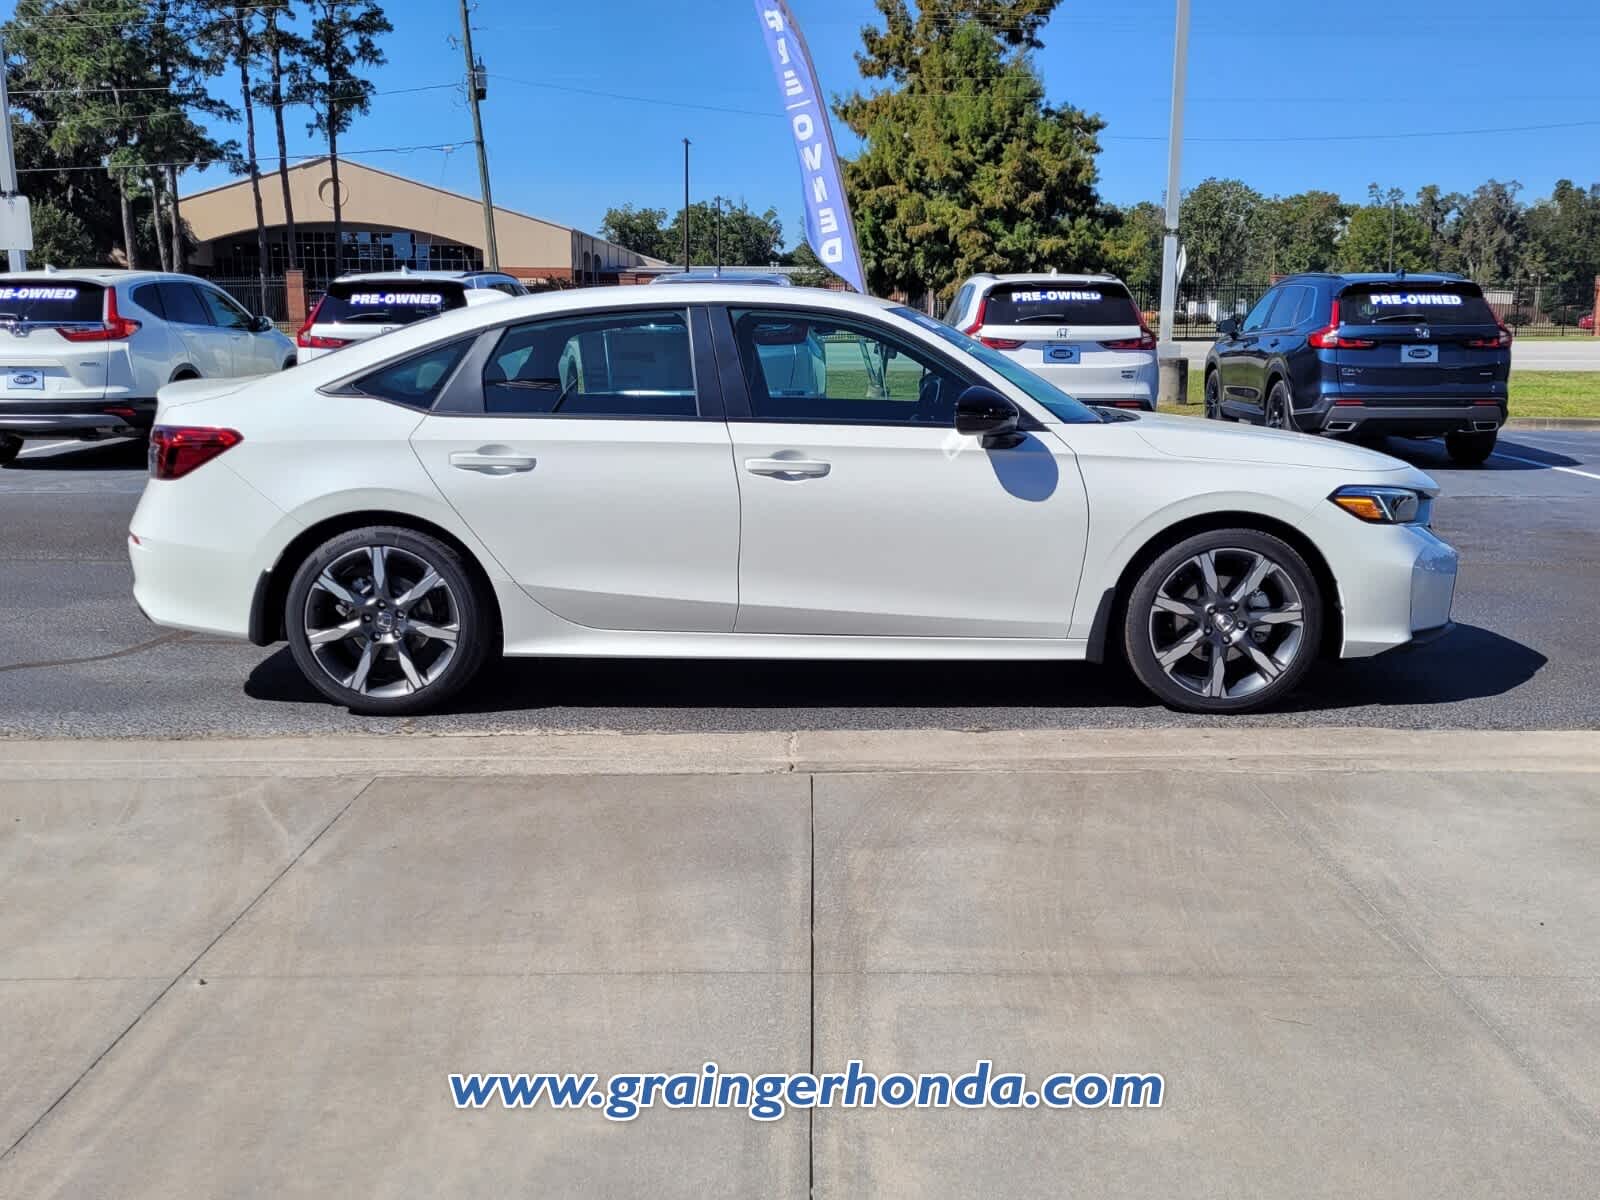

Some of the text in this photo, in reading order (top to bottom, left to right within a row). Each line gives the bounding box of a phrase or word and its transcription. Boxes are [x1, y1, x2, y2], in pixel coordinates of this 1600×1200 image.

[350, 293, 442, 304] PRE-OWNED
[1011, 290, 1102, 302] PRE-OWNED
[1370, 294, 1462, 305] PRE-OWNED
